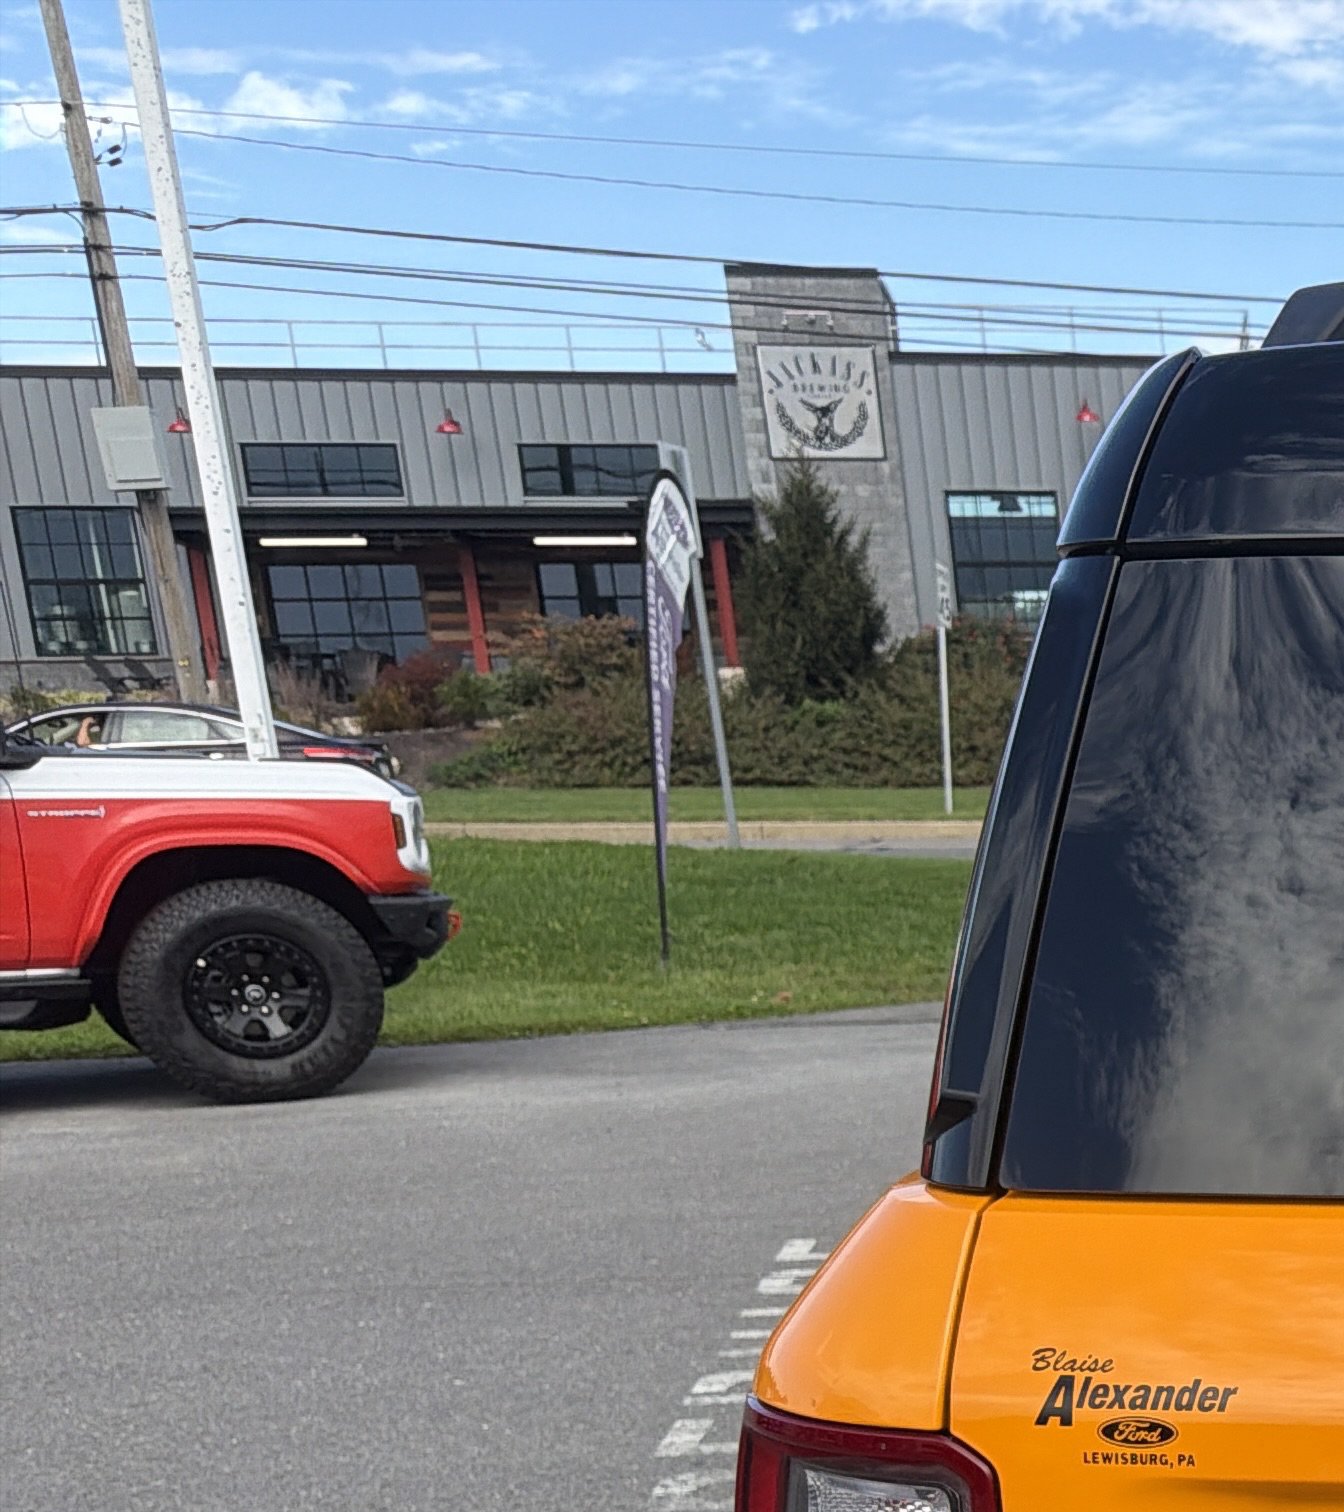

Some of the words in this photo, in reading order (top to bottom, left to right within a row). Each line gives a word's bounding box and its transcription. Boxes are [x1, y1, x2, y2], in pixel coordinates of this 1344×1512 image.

[1032, 1348, 1115, 1373] Blaise
[1034, 1375, 1239, 1427] Alexander
[1113, 1421, 1161, 1442] Ford
[1083, 1452, 1174, 1469] LEWISBURG,
[1178, 1454, 1195, 1466] PA
